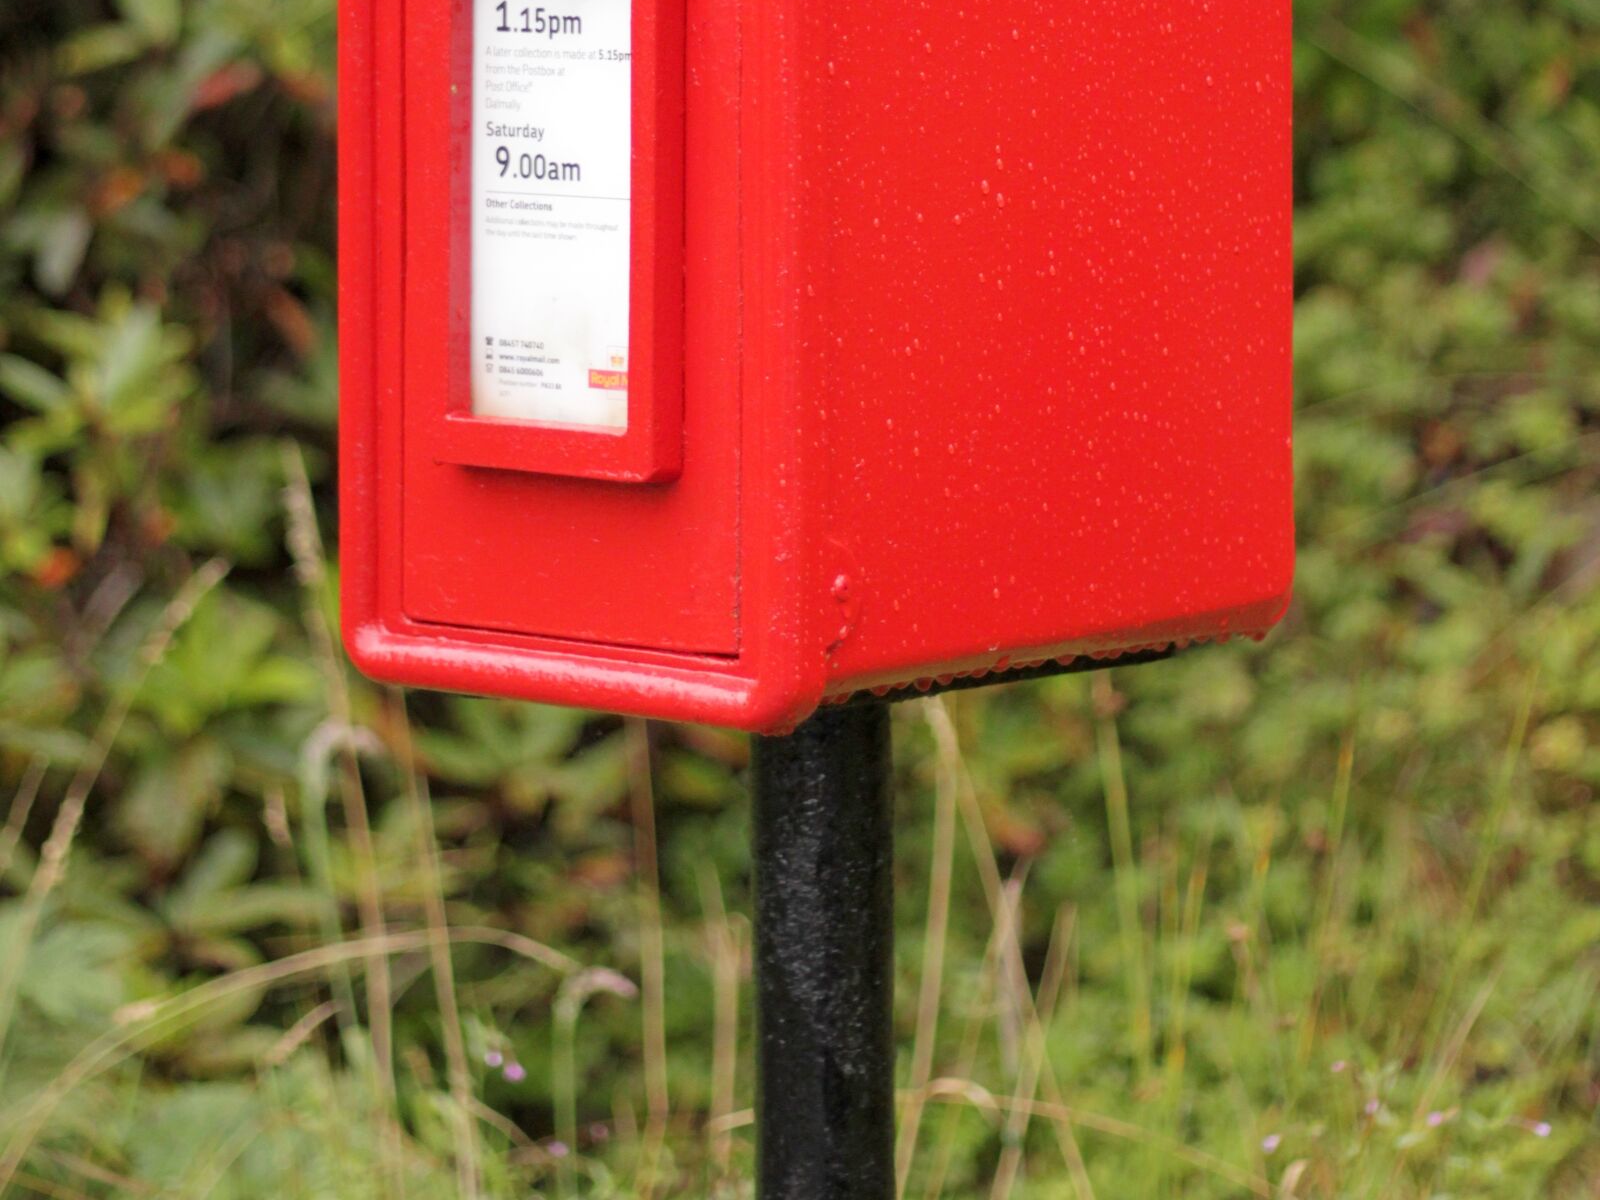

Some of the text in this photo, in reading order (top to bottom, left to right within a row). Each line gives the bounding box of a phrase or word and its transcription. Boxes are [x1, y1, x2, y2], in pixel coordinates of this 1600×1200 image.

[496, 0, 582, 40] 1.15pm
[493, 47, 512, 57] later
[514, 47, 552, 58] collection
[562, 49, 586, 60] made
[486, 64, 506, 74] from
[507, 64, 521, 75] the
[486, 121, 545, 142] Saturday
[496, 145, 581, 182] 9.00am
[486, 198, 553, 211] Other Collections
[591, 371, 620, 388] Royal
